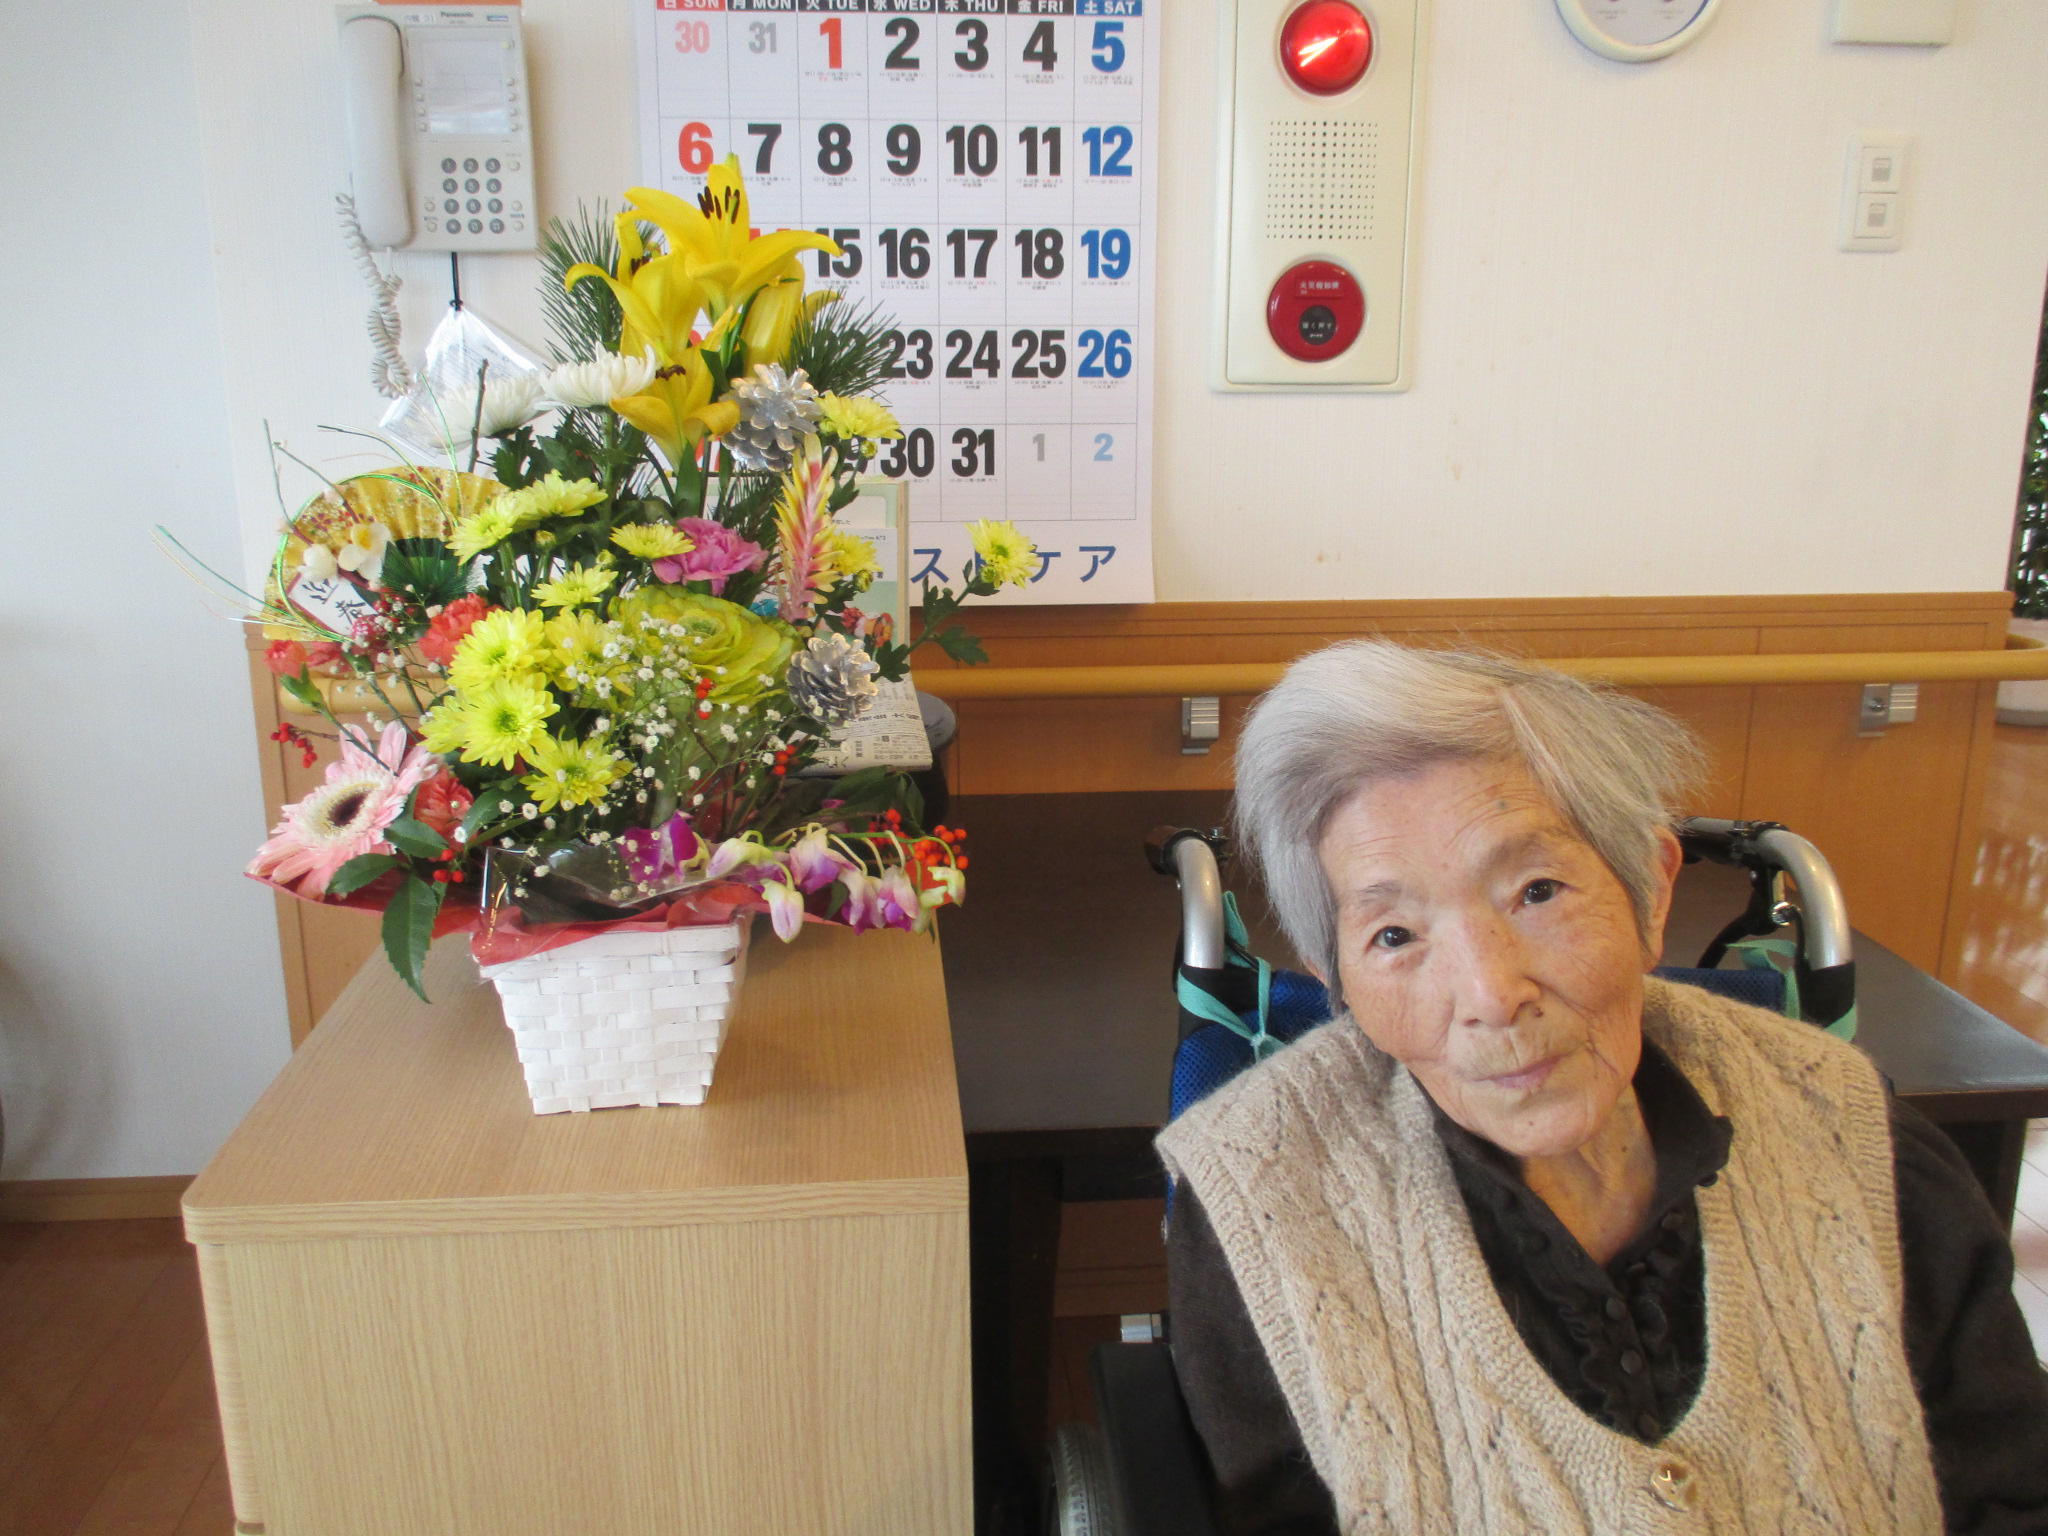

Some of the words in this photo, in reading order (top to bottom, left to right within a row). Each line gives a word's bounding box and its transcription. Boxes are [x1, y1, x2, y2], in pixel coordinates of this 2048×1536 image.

[683, 0, 719, 9] SUN
[752, 0, 792, 9] MON
[827, 0, 859, 10] TUE
[894, 0, 931, 11] WED
[965, 0, 998, 12] THU
[1038, 0, 1064, 12] FRI
[1104, 1, 1136, 14] SAT
[676, 21, 710, 53] 30
[749, 22, 777, 54] 31
[819, 18, 843, 69] 1
[885, 18, 920, 70] 2
[954, 19, 989, 71] 3
[1022, 21, 1057, 71] 4
[1091, 21, 1125, 73] 5
[678, 122, 714, 175] 6
[747, 123, 782, 175] 7
[817, 123, 853, 176] 8
[886, 124, 921, 176] 9
[946, 125, 998, 177] 10
[1018, 126, 1061, 176] 11
[1082, 126, 1133, 177] 12
[817, 228, 862, 279] 15
[878, 229, 930, 279] 16
[946, 229, 998, 279] 17
[1015, 229, 1064, 280] 18
[1080, 229, 1131, 280] 19
[880, 329, 934, 379] 23
[945, 329, 1000, 379] 24
[1011, 329, 1066, 379] 25
[1078, 329, 1132, 379] 26
[880, 428, 935, 479] 30
[951, 428, 995, 478] 31
[1033, 433, 1045, 461] 1
[1093, 433, 1114, 462] 2
